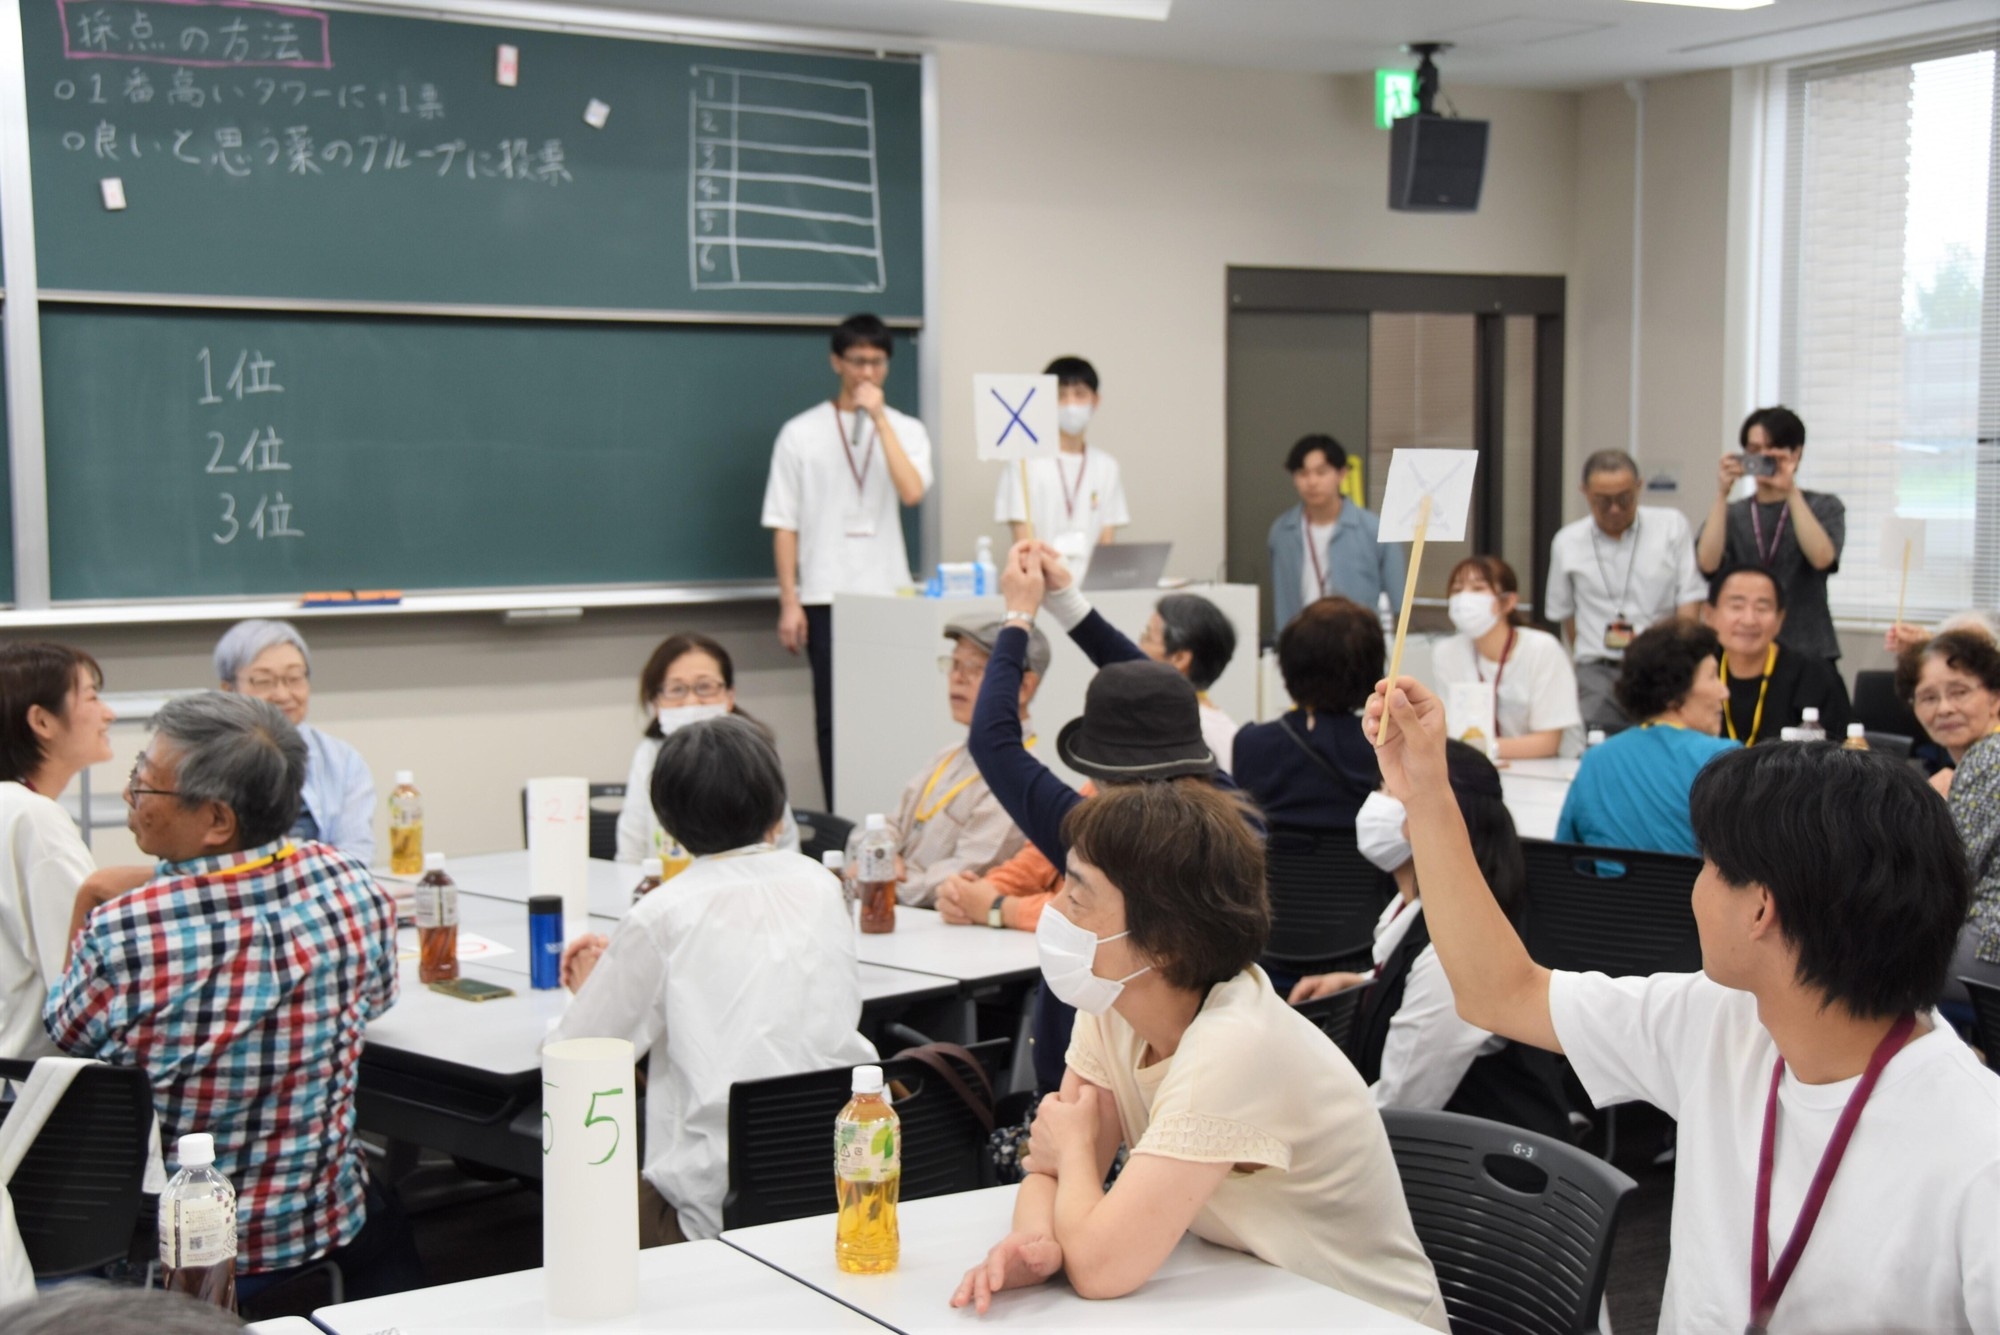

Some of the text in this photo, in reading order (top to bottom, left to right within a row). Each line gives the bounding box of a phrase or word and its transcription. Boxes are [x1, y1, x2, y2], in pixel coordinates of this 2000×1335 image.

[77, 8, 303, 63] 採点の方法
[197, 346, 286, 404] 1位
[206, 425, 293, 474] 2位
[212, 491, 306, 545] 3位
[584, 1087, 624, 1165] 5
